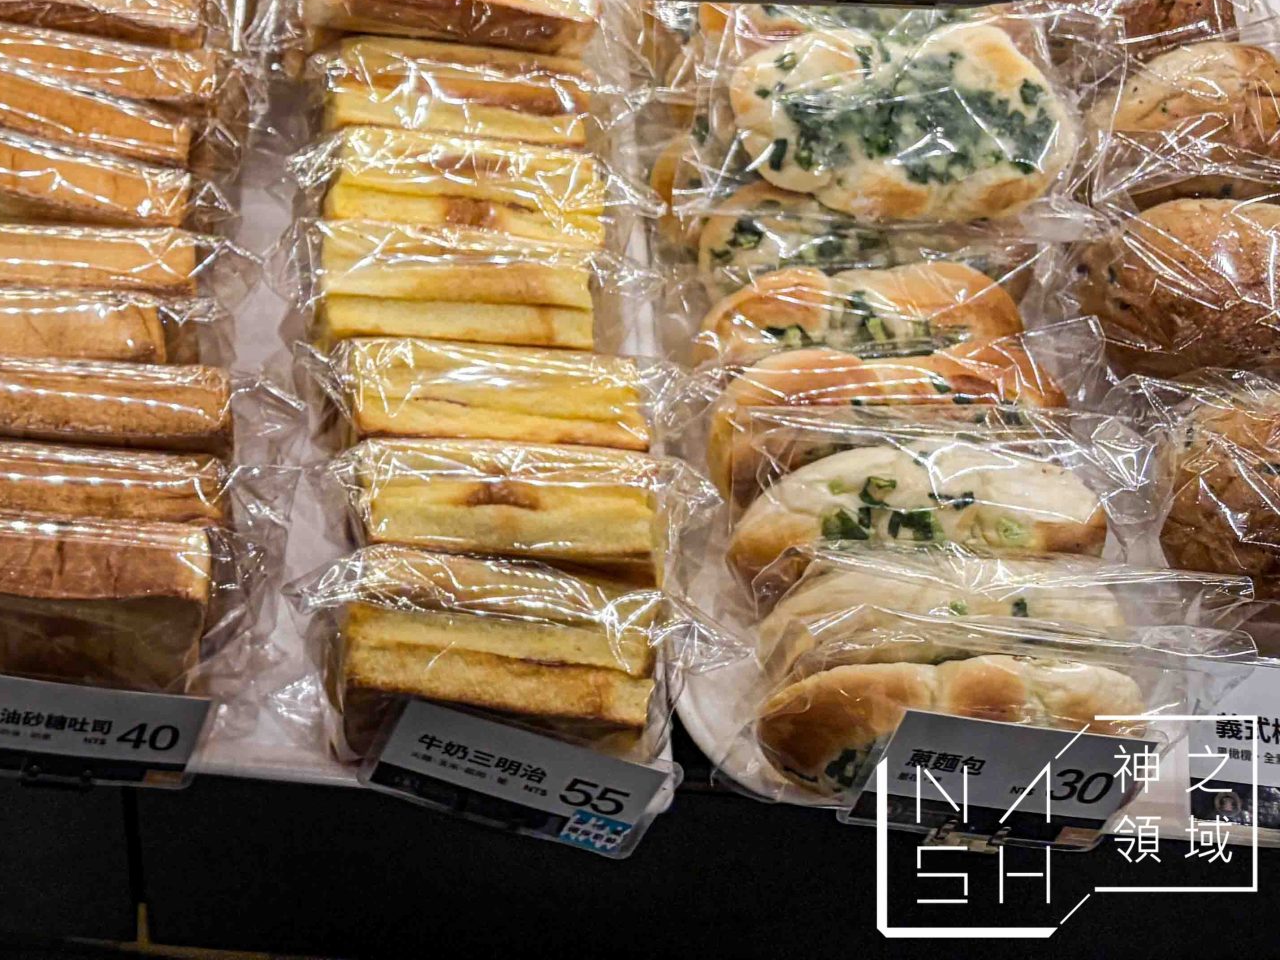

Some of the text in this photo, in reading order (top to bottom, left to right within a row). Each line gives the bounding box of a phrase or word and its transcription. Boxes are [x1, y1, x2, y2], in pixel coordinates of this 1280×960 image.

[116, 722, 180, 751] 40
[418, 733, 547, 784] 牛奶三明治
[559, 778, 631, 816] 55
[1049, 768, 1114, 804] 30
